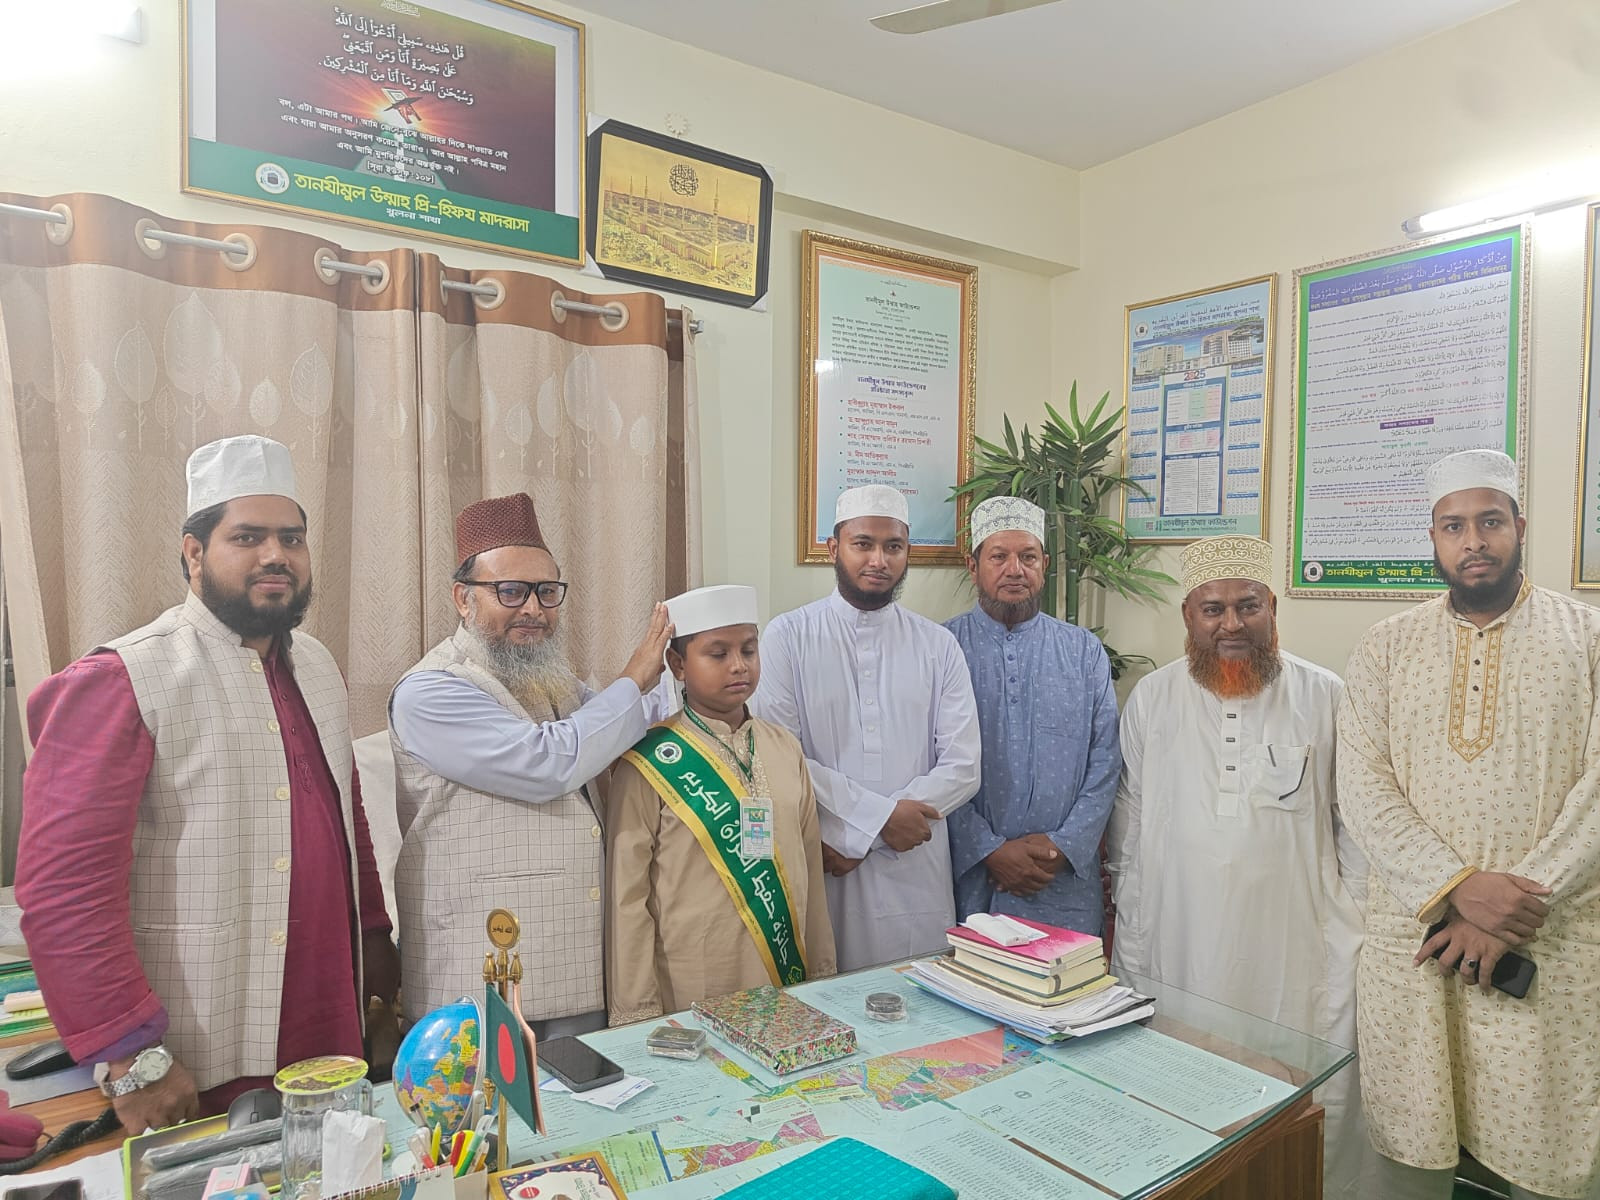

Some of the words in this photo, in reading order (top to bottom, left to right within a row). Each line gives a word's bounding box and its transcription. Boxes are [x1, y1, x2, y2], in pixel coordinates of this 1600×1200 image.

[280, 114, 299, 125] এবং
[300, 118, 317, 129] যারা
[319, 122, 342, 134] আমার
[298, 102, 312, 113] এটা
[314, 107, 338, 119] আমার
[360, 116, 378, 128] আমি
[448, 137, 466, 149] দিকে
[336, 142, 354, 152] এবং
[355, 145, 373, 156] আমি
[293, 173, 367, 203] তানযীমুল
[370, 186, 411, 210] উম্মাহ
[479, 210, 531, 233] মাদরাসা
[386, 207, 416, 220] খুলনা
[419, 214, 441, 225] শাখা
[1184, 370, 1206, 382] 2025
[1326, 567, 1373, 578] তানযীমুল
[1376, 567, 1407, 577] উম্মাহ
[678, 771, 732, 821] الكريم
[752, 869, 775, 920] حفظ
